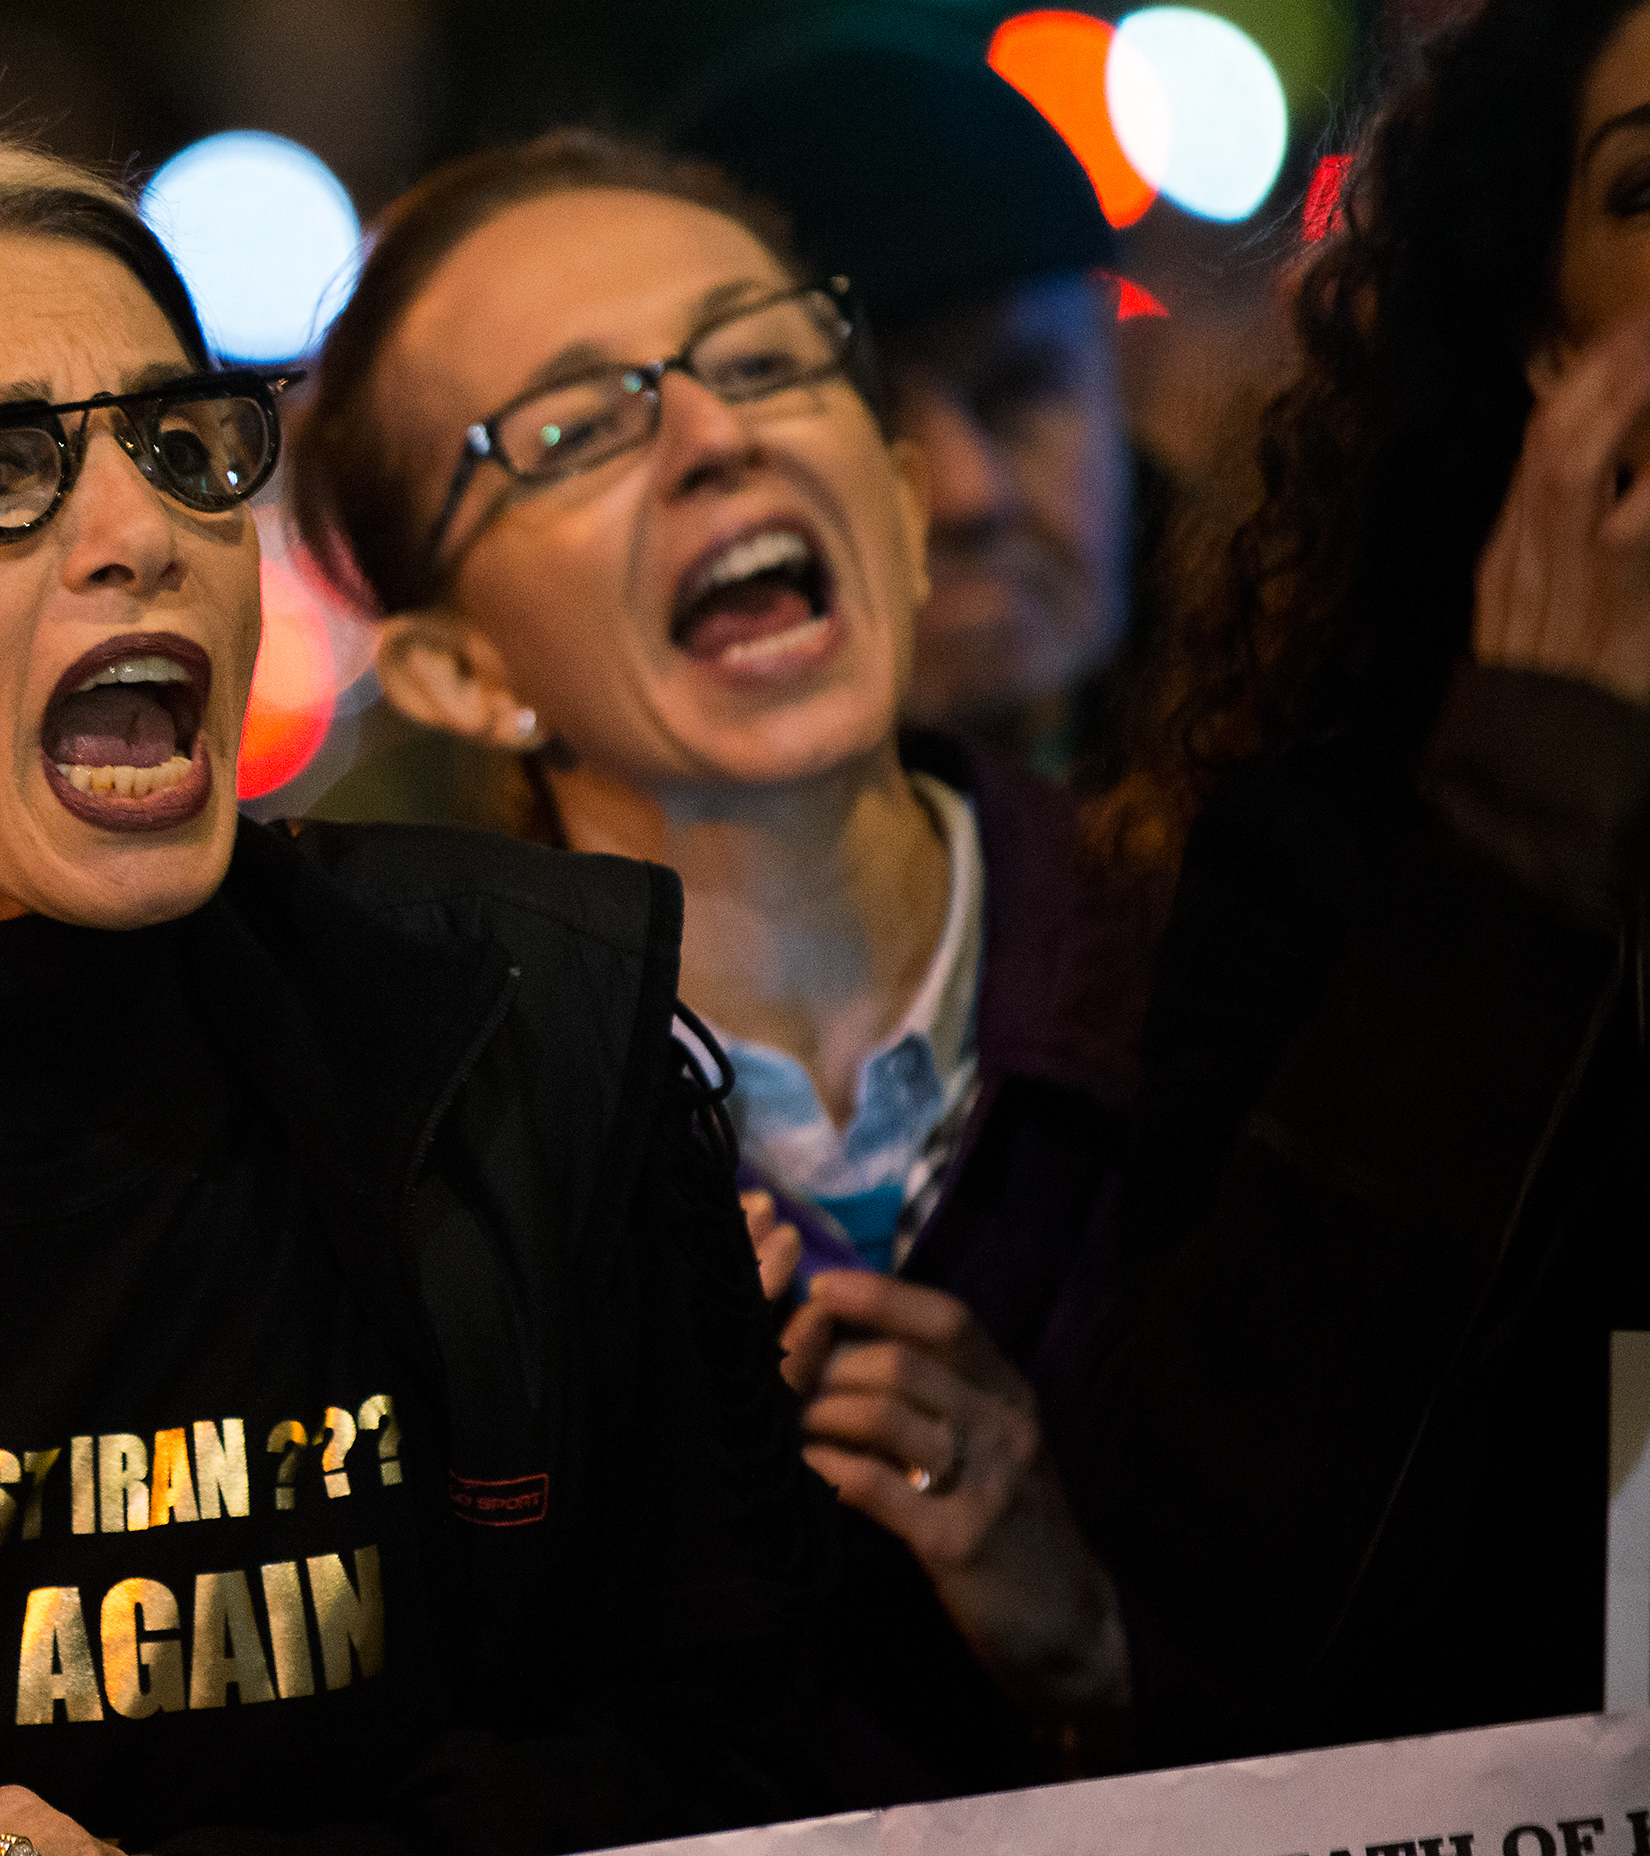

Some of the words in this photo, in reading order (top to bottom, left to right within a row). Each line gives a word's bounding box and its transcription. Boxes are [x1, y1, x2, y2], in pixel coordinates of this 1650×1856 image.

[69, 1417, 251, 1536] IRAN
[476, 1491, 543, 1511] SPORT
[15, 1544, 386, 1727] AGAIN
